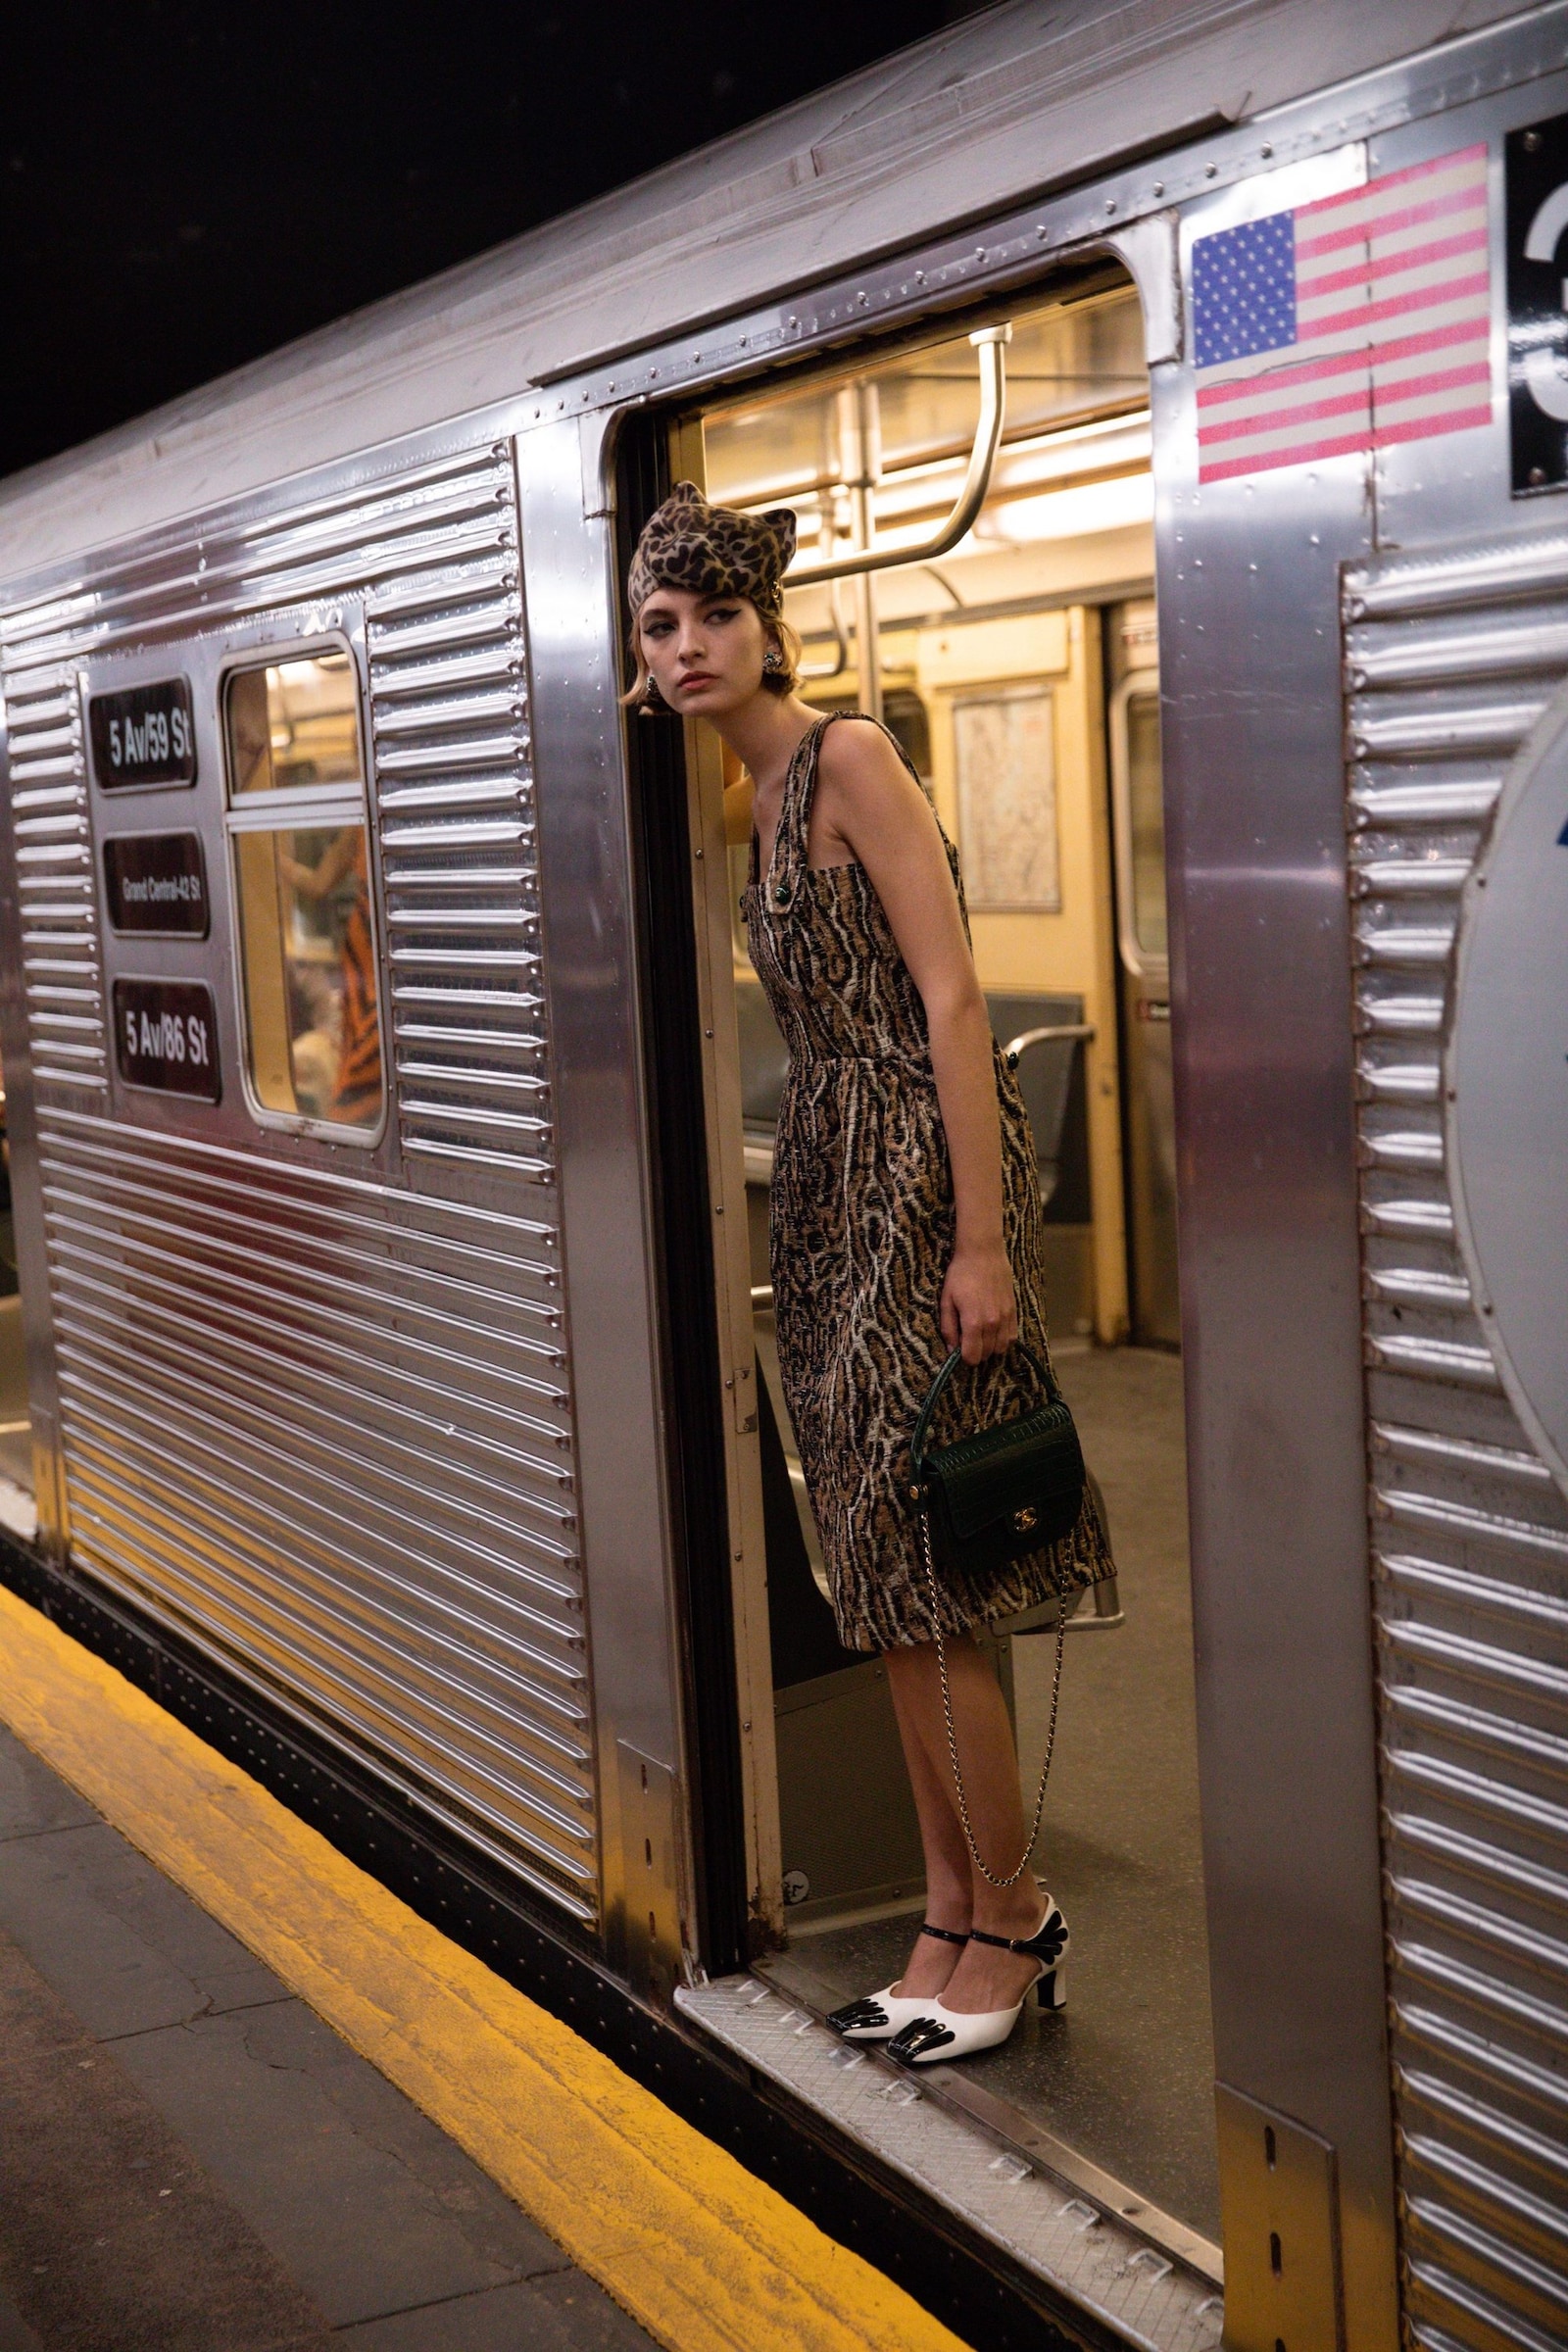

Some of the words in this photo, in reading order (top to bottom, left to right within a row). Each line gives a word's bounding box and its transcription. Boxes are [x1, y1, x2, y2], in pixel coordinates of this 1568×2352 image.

[109, 718, 122, 767] 5
[124, 711, 170, 764] Av/59
[171, 707, 191, 760] St
[125, 1009, 138, 1056] 5
[140, 1009, 185, 1063] Av/86
[187, 1014, 209, 1066] St
